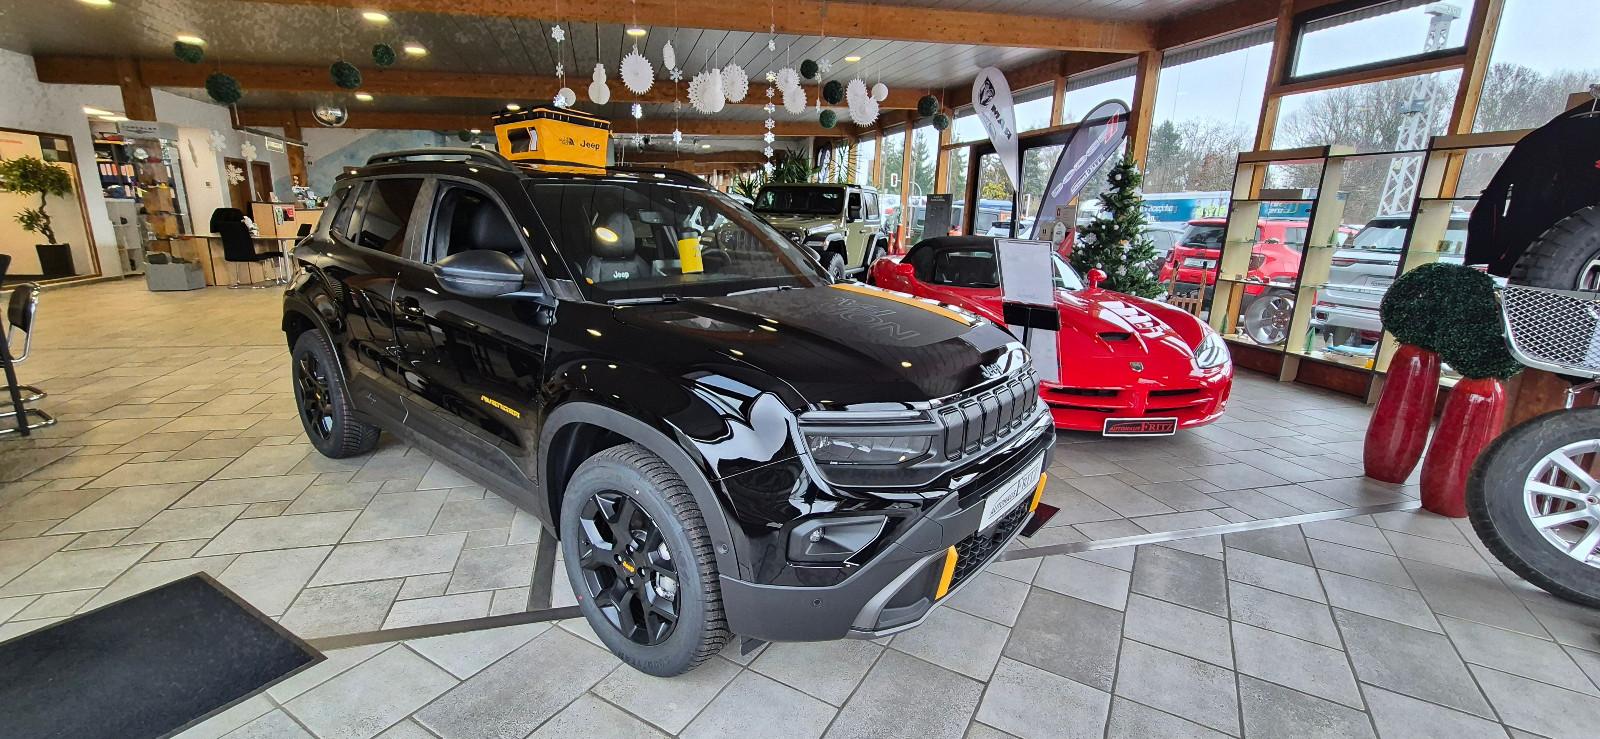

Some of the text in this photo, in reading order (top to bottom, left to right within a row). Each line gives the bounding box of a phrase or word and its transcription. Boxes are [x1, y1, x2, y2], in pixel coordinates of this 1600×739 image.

[580, 140, 600, 150] Jeep
[613, 271, 630, 280] Jeep
[980, 363, 1003, 379] Jeep
[1141, 422, 1174, 432] FRITZ
